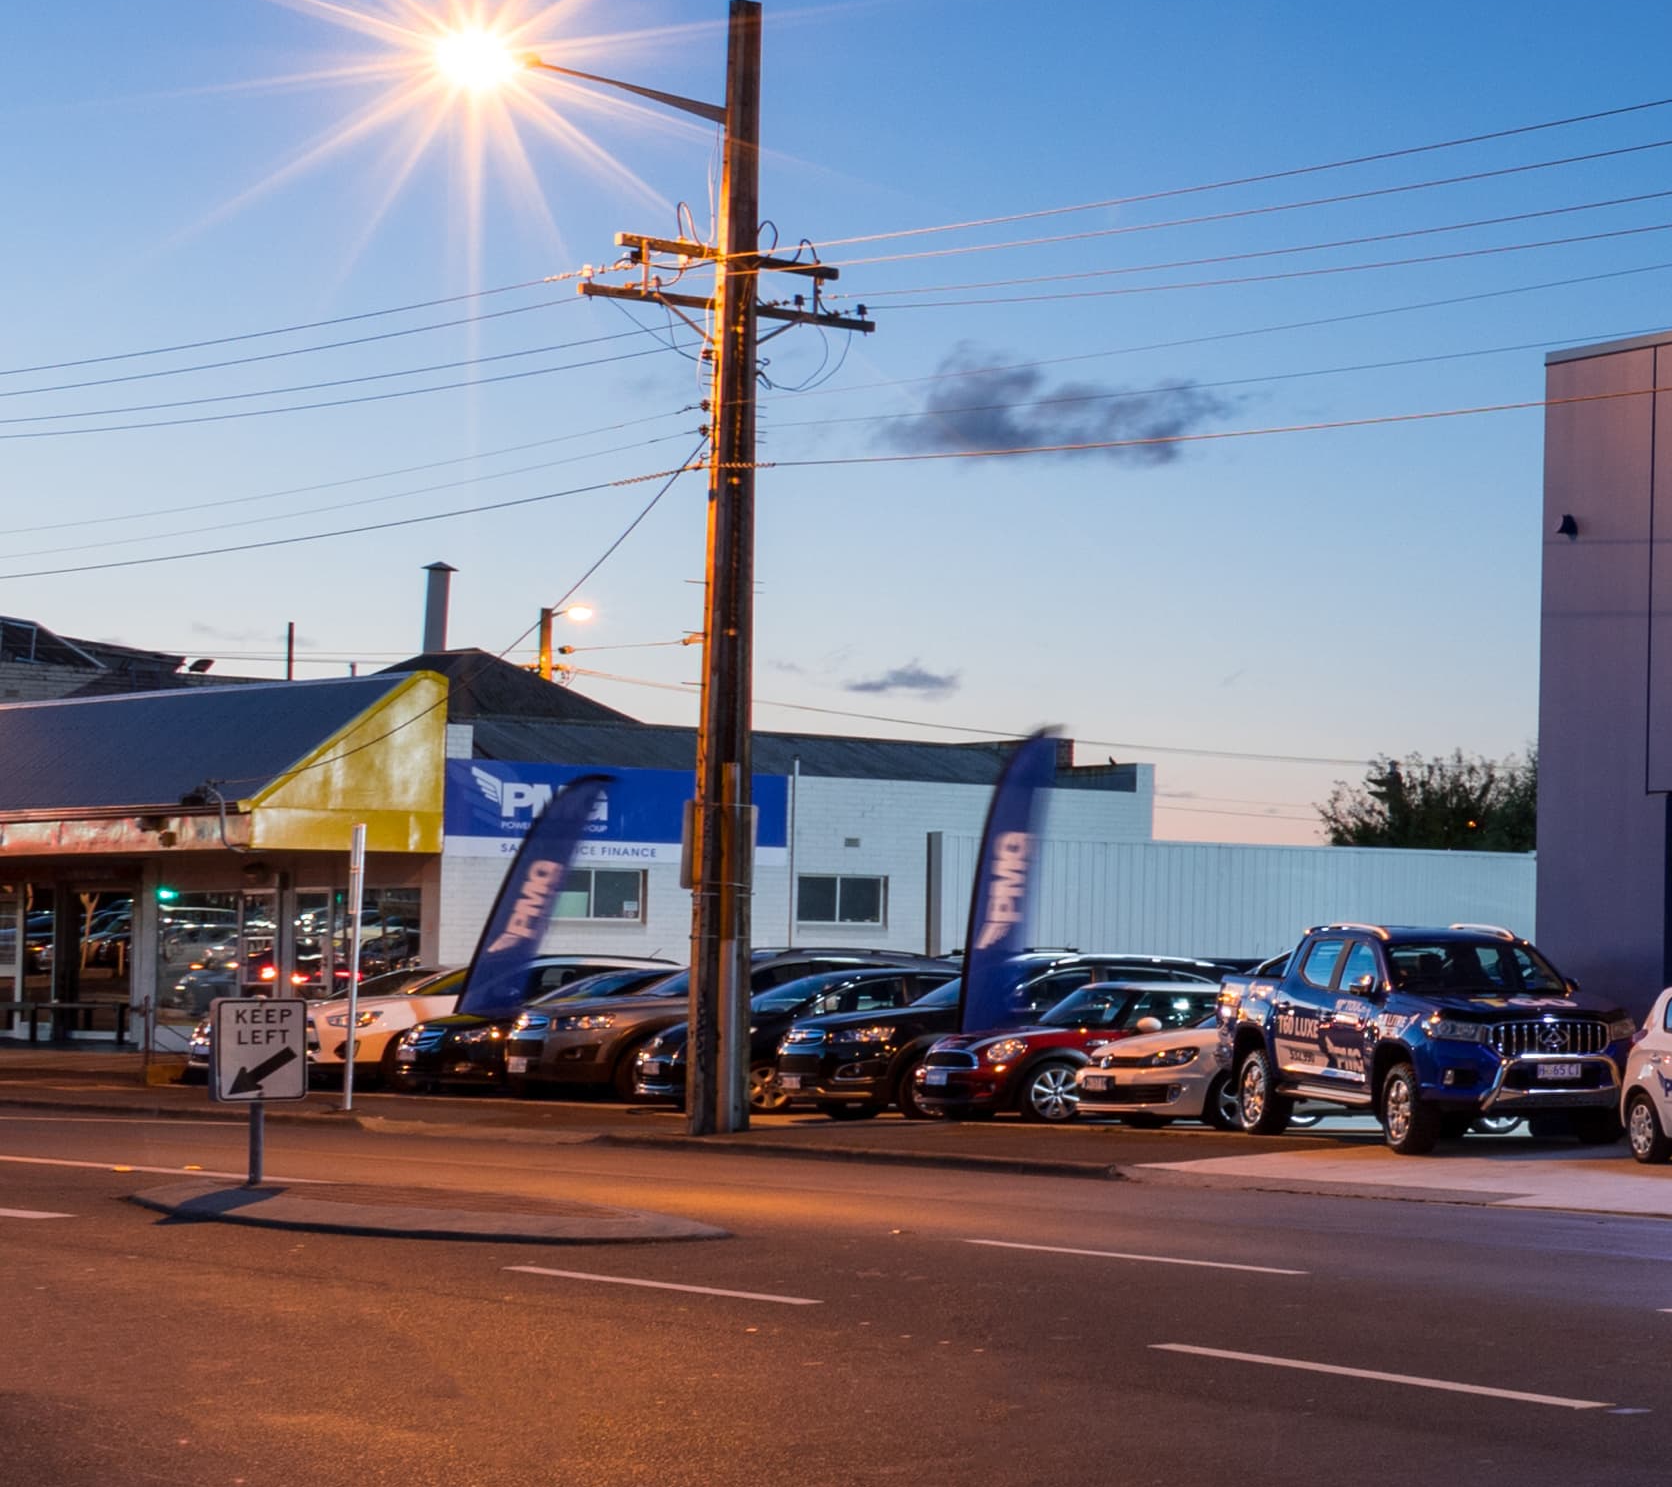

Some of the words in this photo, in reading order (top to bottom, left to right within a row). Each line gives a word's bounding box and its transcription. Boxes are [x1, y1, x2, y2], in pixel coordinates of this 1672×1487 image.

[501, 821, 532, 831] POWE
[600, 845, 657, 858] FINANCE
[235, 1008, 293, 1024] KEEP
[237, 1029, 290, 1045] LEFT
